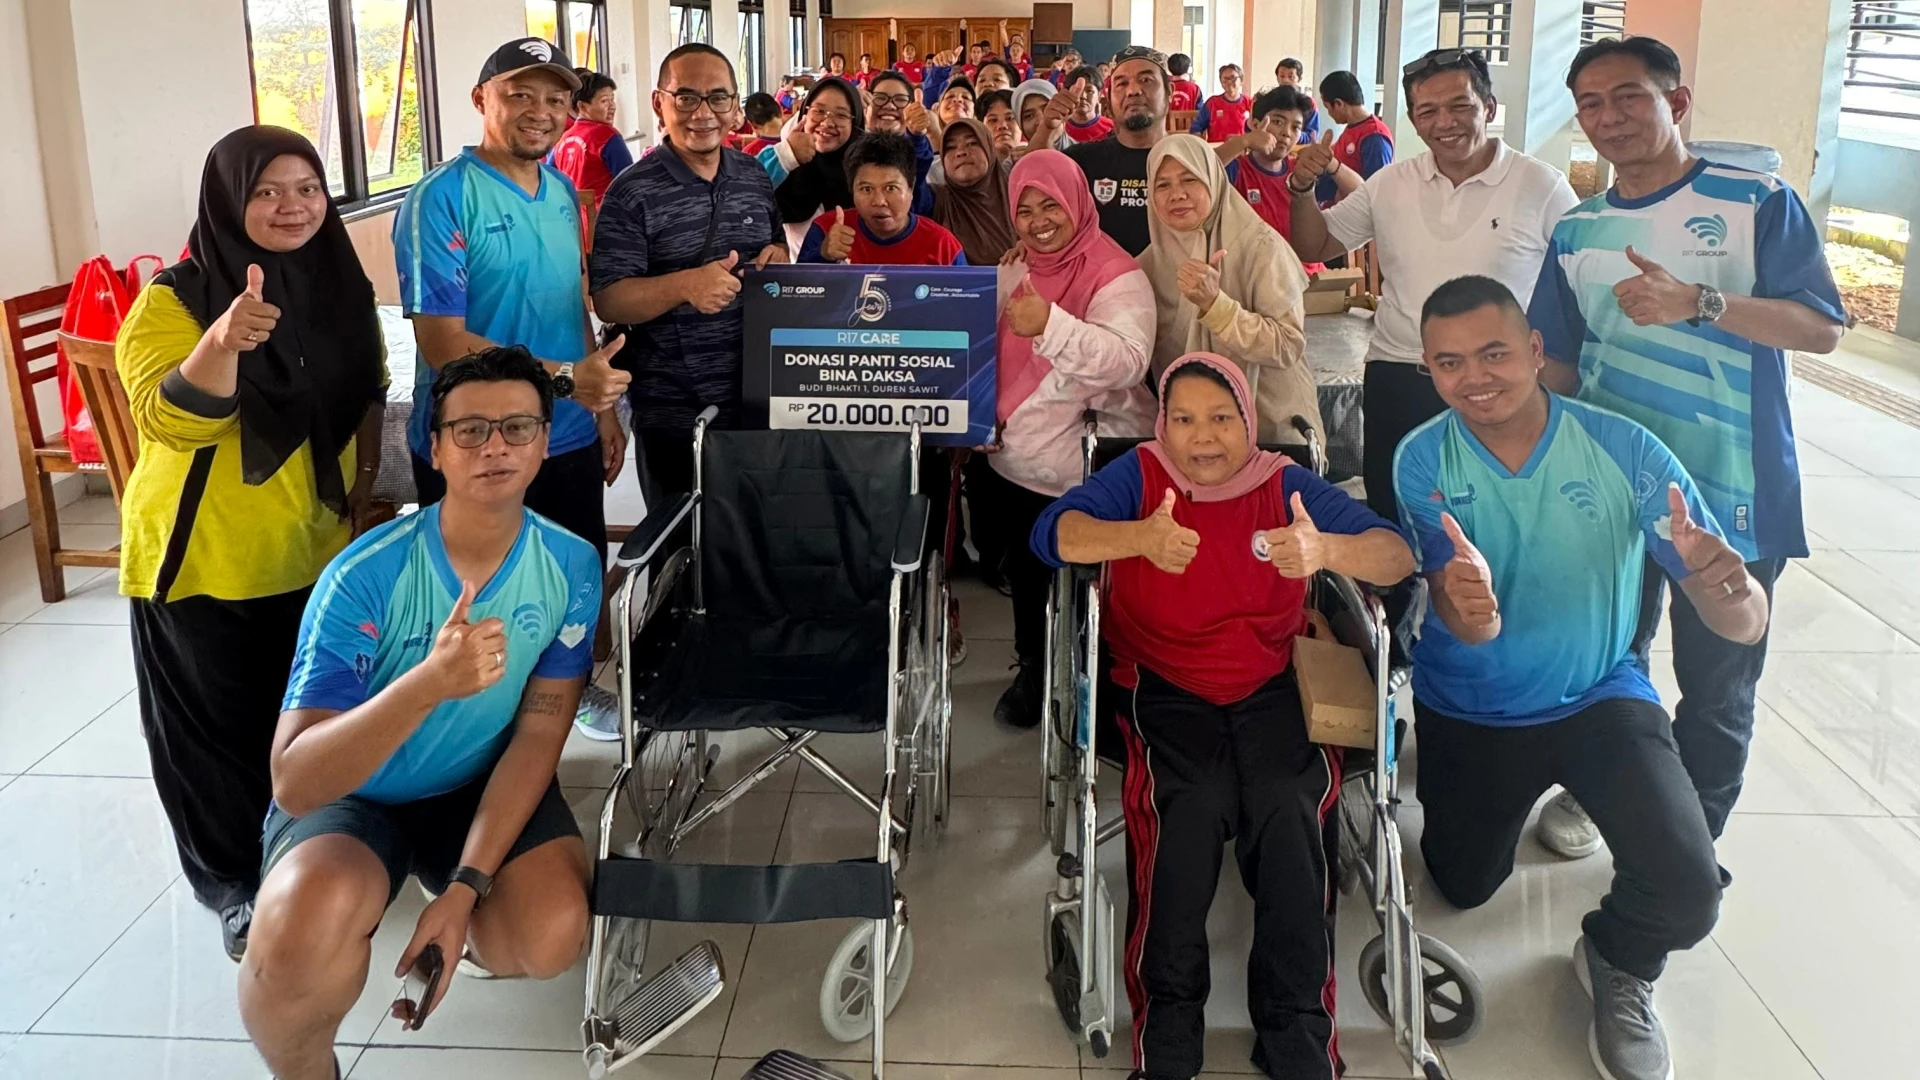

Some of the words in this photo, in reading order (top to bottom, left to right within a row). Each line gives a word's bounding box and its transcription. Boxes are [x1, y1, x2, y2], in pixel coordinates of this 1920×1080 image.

[1120, 188, 1138, 196] TIK
[1120, 198, 1148, 207] PRO
[782, 286, 795, 294] R17
[795, 286, 825, 294] GROUP
[837, 331, 858, 344] R17
[860, 332, 900, 345] CARE
[784, 353, 844, 366] DONASI
[848, 354, 895, 367] PANTI
[898, 355, 955, 368] SOSIAL
[819, 369, 858, 382] BINA
[861, 370, 915, 383] DAKSA
[799, 384, 823, 392] BUDI
[826, 384, 861, 392] BHAKTI
[863, 385, 870, 393] 1,
[872, 385, 906, 393] DUREN
[908, 386, 939, 394] SAWIT
[788, 403, 804, 412] RP
[807, 403, 949, 426] 20.000.000
